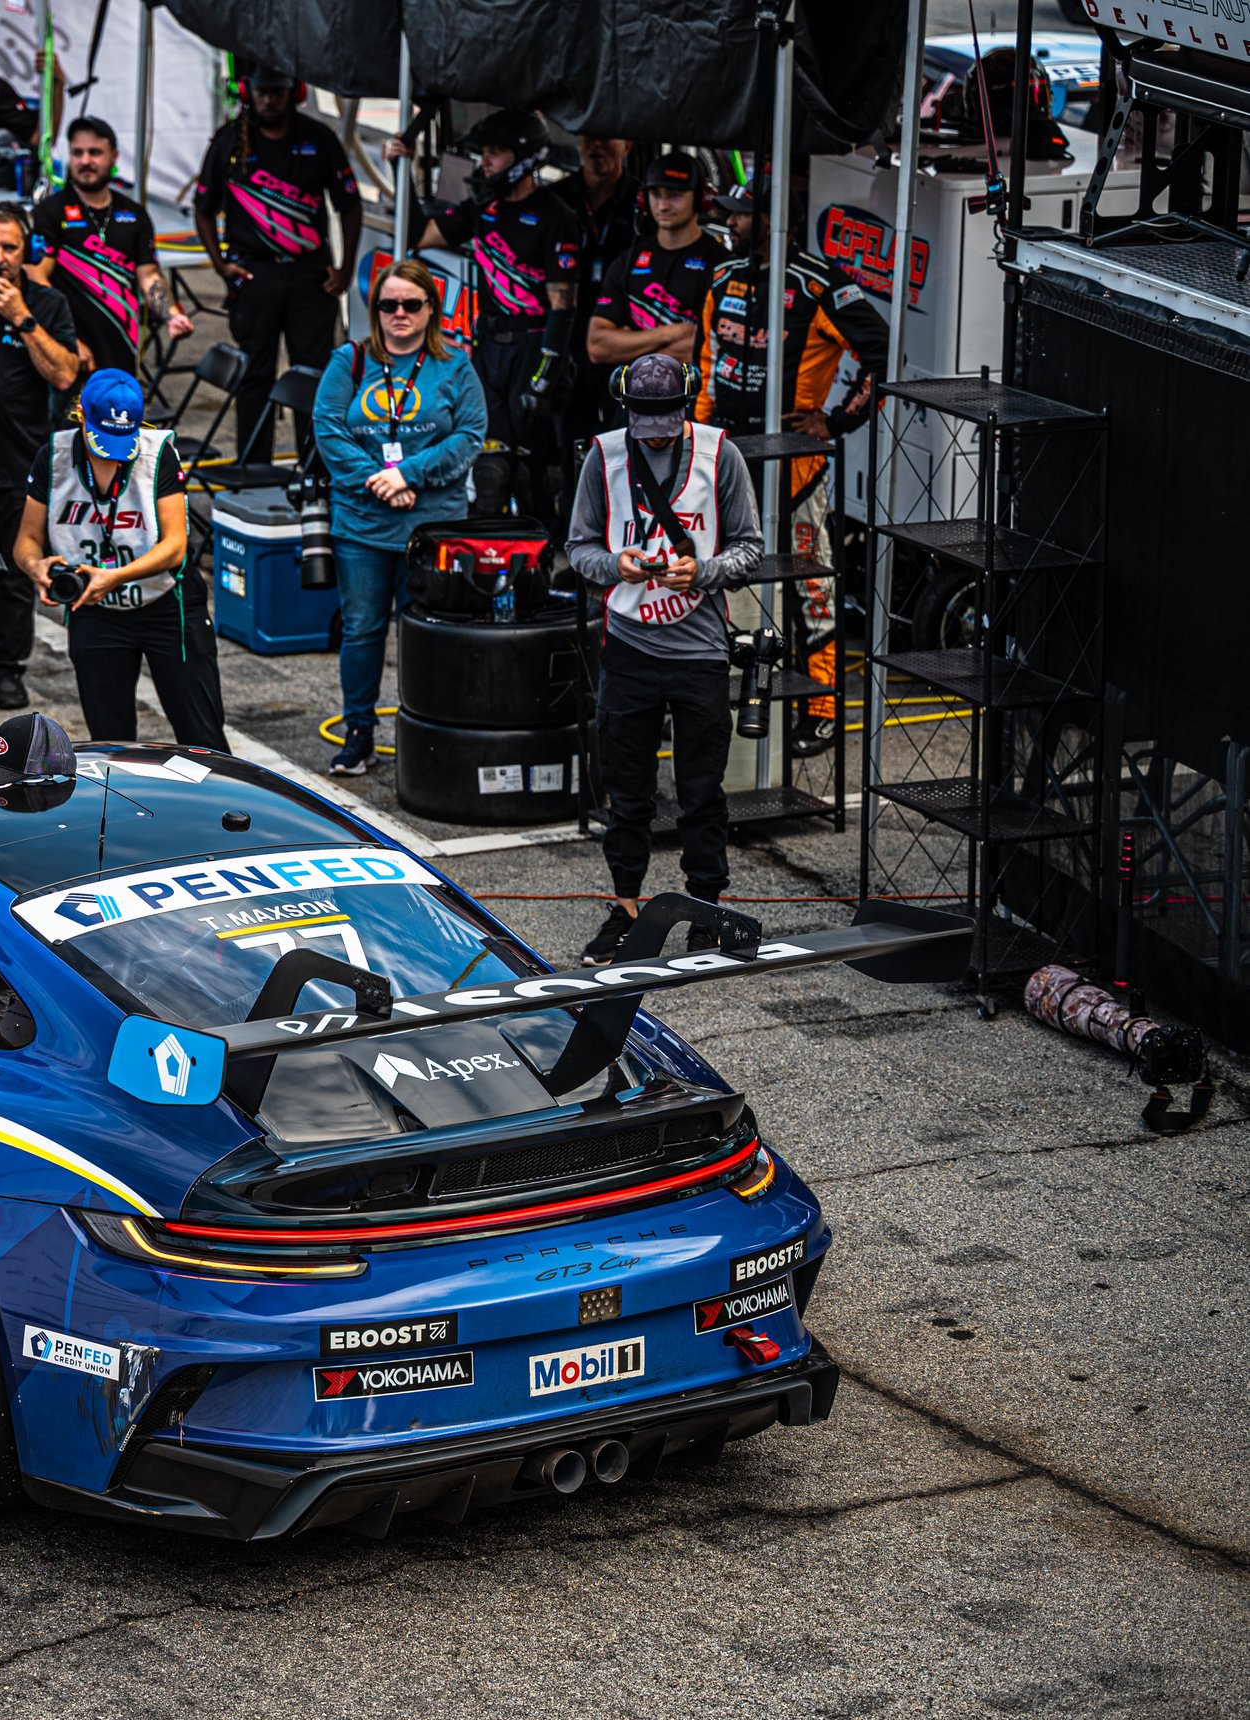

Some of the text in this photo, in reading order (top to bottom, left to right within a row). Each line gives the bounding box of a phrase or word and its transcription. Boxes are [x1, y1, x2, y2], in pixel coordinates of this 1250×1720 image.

[823, 206, 929, 285] COPELAD
[413, 422, 437, 433] CUP
[127, 856, 406, 910] PENFED
[467, 1224, 689, 1270] PORSCHE
[535, 1255, 641, 1282] GT3 Cup
[736, 1245, 794, 1282] EBOOST
[724, 1283, 790, 1319] YOKOHAMA
[55, 1340, 112, 1366] PENFED
[329, 1324, 426, 1350] EBOOST
[54, 1354, 111, 1376] CREDIT UNION
[357, 1361, 465, 1390] YOKOHAMA
[534, 1345, 636, 1390] Mobil 1
